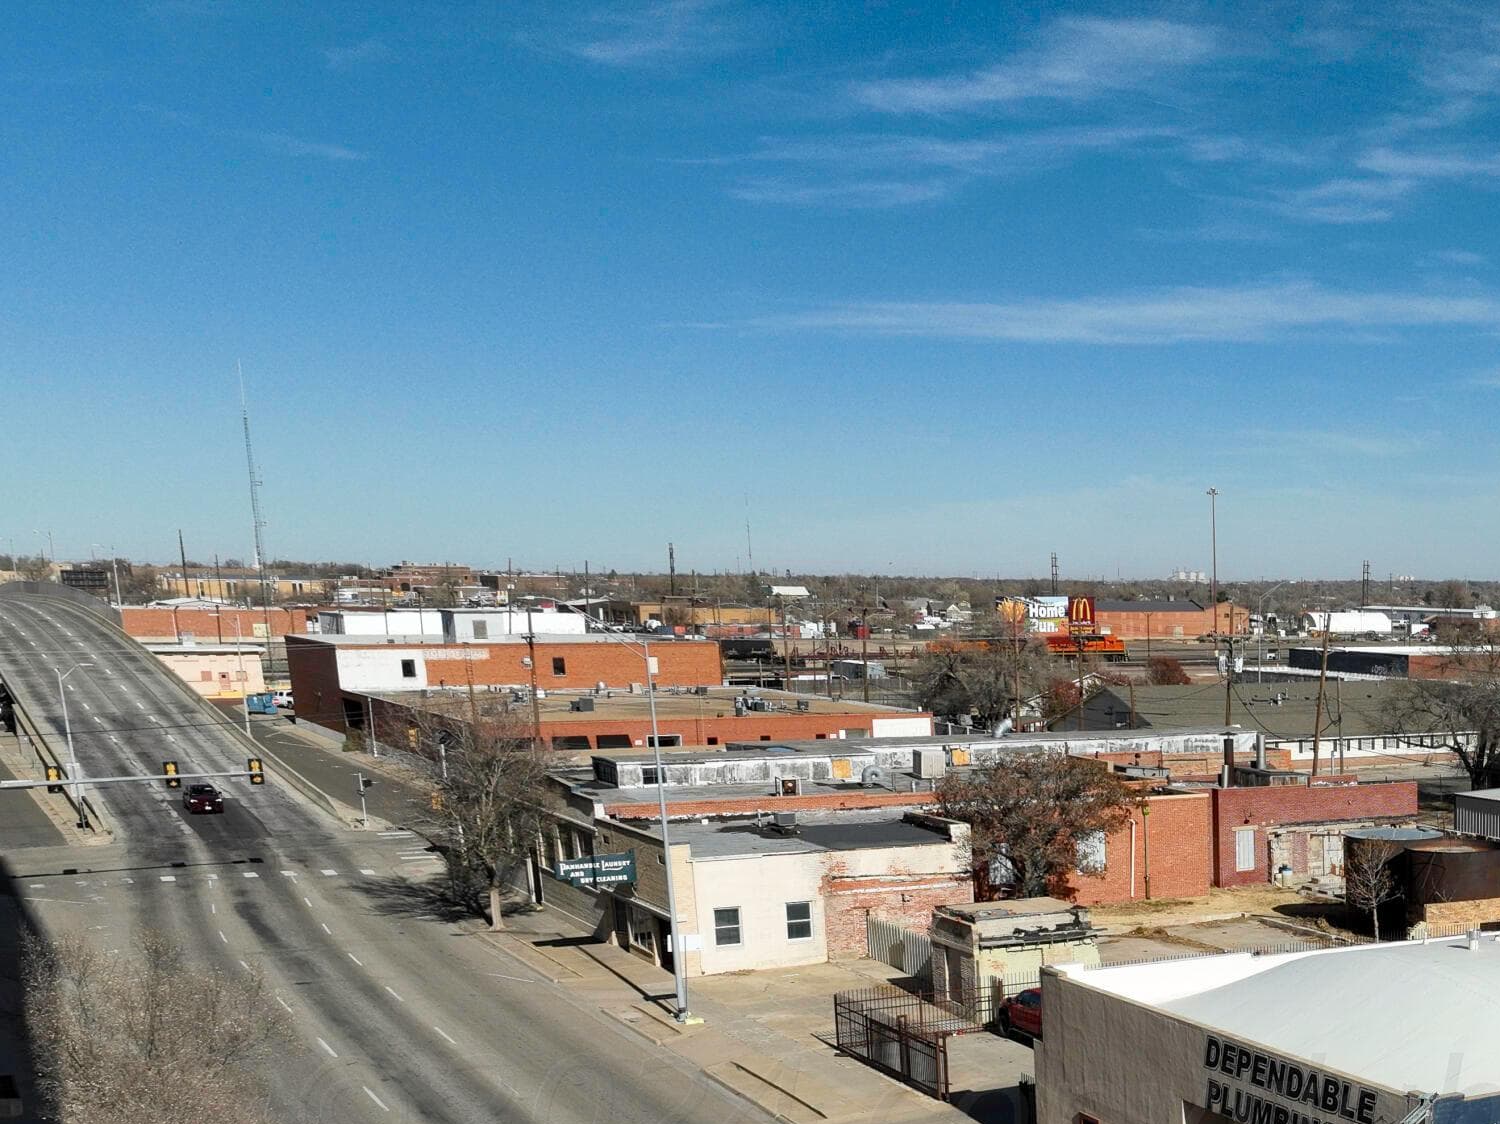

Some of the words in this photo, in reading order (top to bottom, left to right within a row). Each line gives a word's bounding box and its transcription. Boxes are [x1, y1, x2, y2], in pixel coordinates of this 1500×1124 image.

[1029, 602, 1066, 618] Home
[601, 860, 631, 871] LAUNDRY
[596, 874, 628, 883] CLEANING
